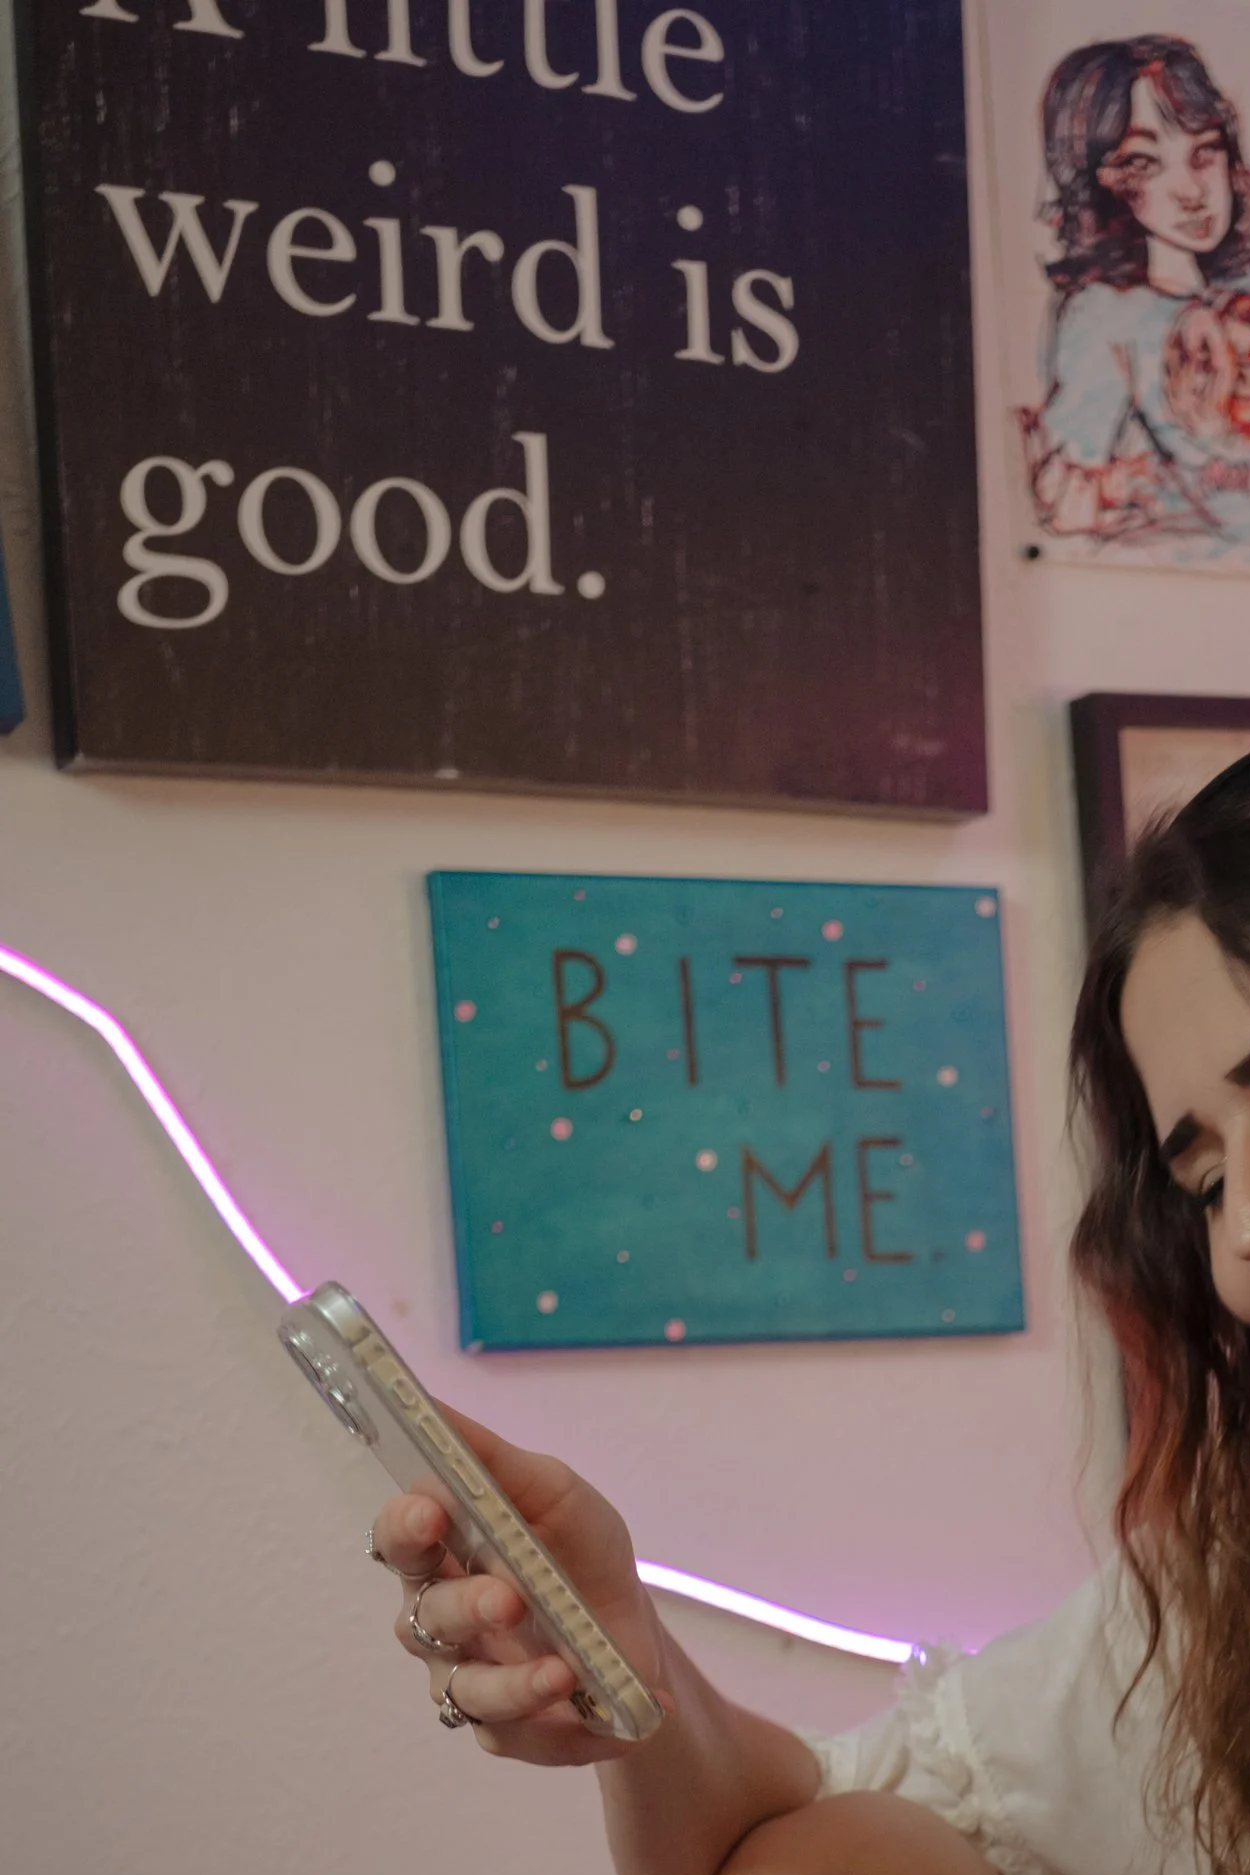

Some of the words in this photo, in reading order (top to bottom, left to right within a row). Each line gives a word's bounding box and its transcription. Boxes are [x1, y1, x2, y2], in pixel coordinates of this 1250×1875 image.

[94, 160, 615, 350] weird
[672, 204, 801, 373] is
[116, 432, 606, 630] good.
[552, 948, 904, 1091] BITE
